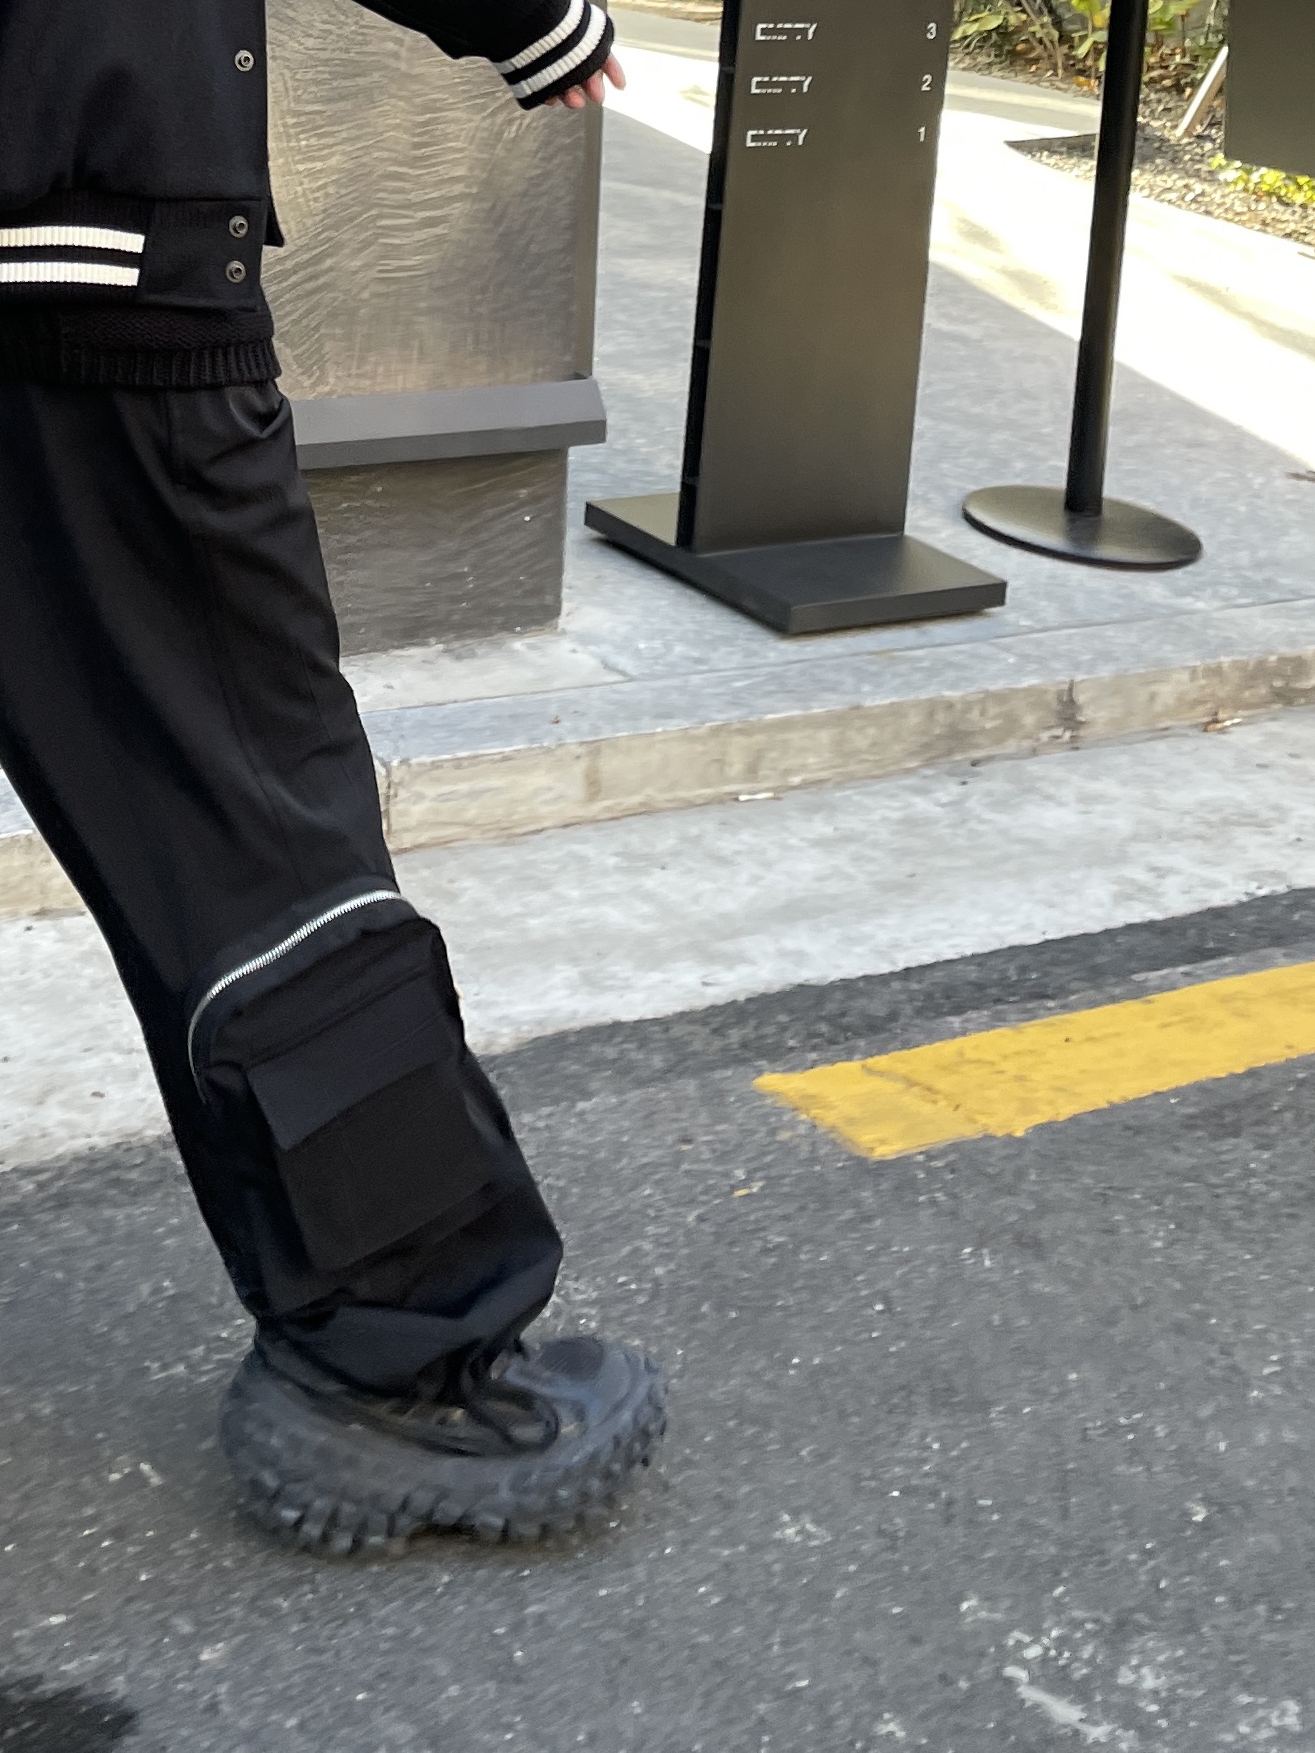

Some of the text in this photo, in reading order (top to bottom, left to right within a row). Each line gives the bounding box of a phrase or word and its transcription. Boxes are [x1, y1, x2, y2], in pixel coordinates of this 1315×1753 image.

[926, 23, 937, 39] 3
[921, 74, 932, 91] 2
[917, 127, 926, 142] 1
